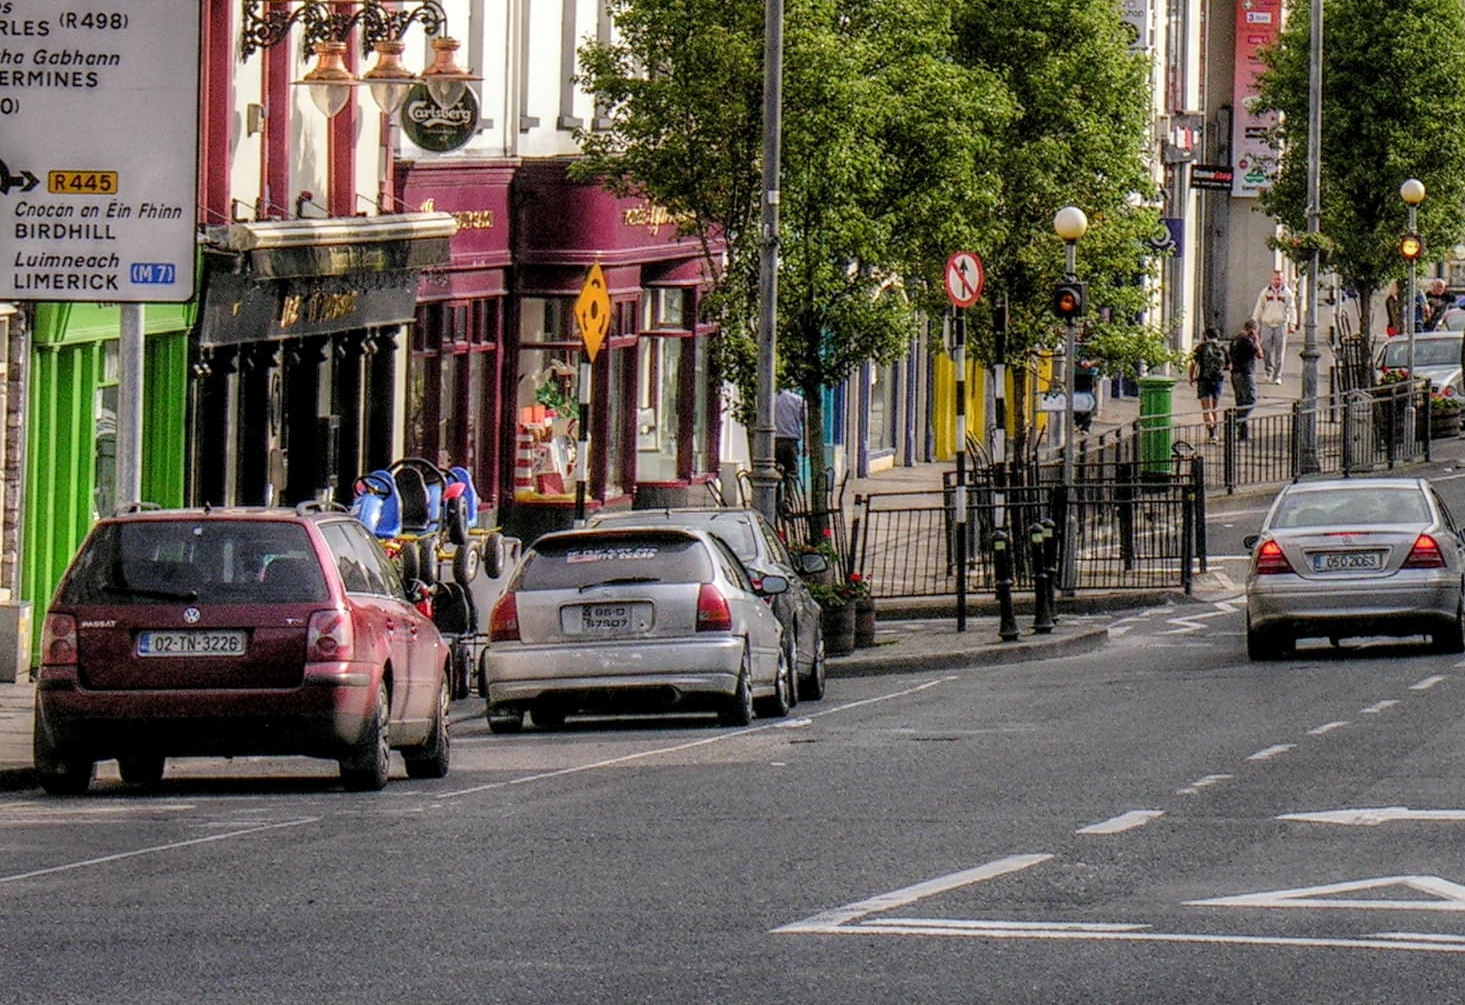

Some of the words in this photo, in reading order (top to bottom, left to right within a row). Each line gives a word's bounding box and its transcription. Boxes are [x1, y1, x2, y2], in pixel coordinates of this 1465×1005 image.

[33, 49, 121, 66] Gabhann
[408, 100, 472, 124] Carlsberg
[15, 201, 74, 218] Cnocán
[81, 205, 99, 218] an
[138, 203, 182, 220] Fhinn
[15, 224, 116, 239] BIRDHILL
[14, 252, 120, 269] Luimneach
[14, 274, 119, 290] LIMERICK
[82, 620, 117, 628] PASSAT
